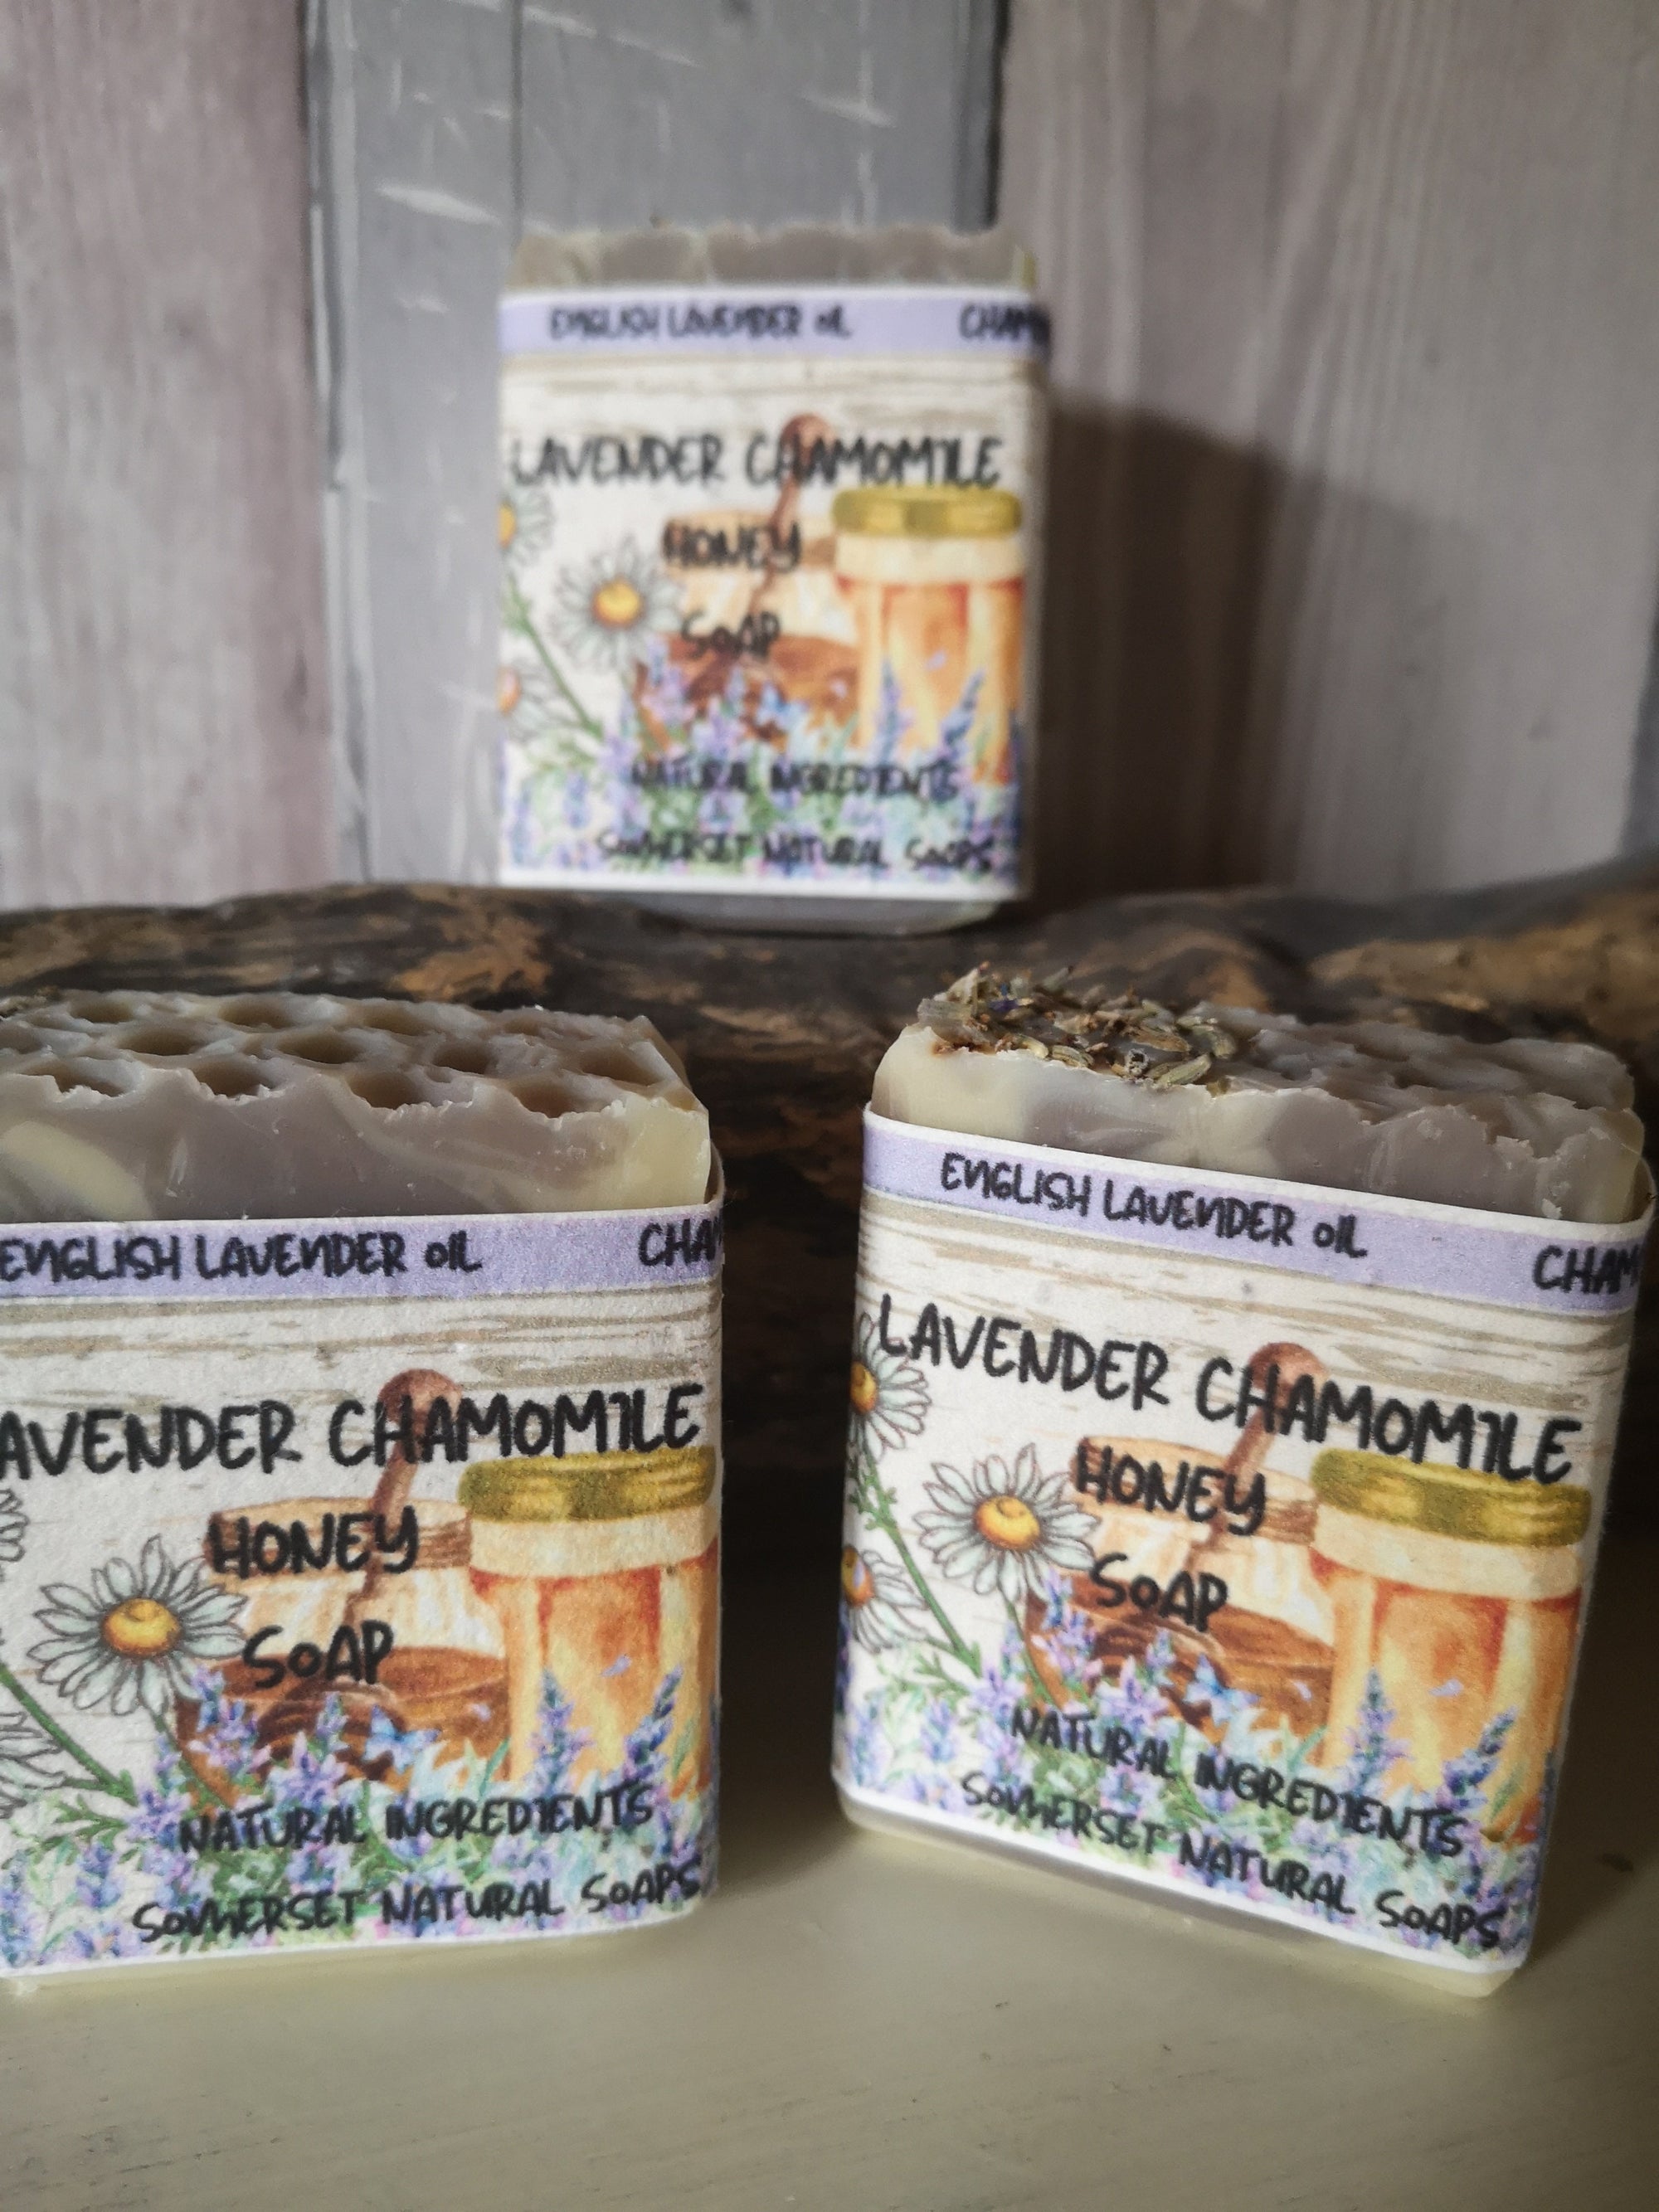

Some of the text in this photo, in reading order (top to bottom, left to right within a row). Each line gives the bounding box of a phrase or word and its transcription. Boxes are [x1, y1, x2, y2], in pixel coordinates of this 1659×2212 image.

[509, 432, 1004, 489] LAVENDER CHAMOMILE
[663, 518, 802, 573] HONEY
[941, 1151, 1092, 1218] ENGLISH
[1103, 1177, 1294, 1249] LAVENDER
[0, 1234, 178, 1282] ENGLISH
[195, 1230, 407, 1279] LAVENDER
[331, 1383, 704, 1467] CHAMOMILE
[879, 1293, 1584, 1484] LAVENDER CHAMOMILE
[1077, 1445, 1267, 1537] HONEY
[207, 1505, 421, 1579] HONEY
[179, 1780, 654, 1855] NATURAL INGREDIENTS
[1010, 1705, 1464, 1859] NATURAL INGREDIENTS
[382, 1877, 565, 1926] NATURAL
[1179, 1830, 1355, 1915] NATURAL
